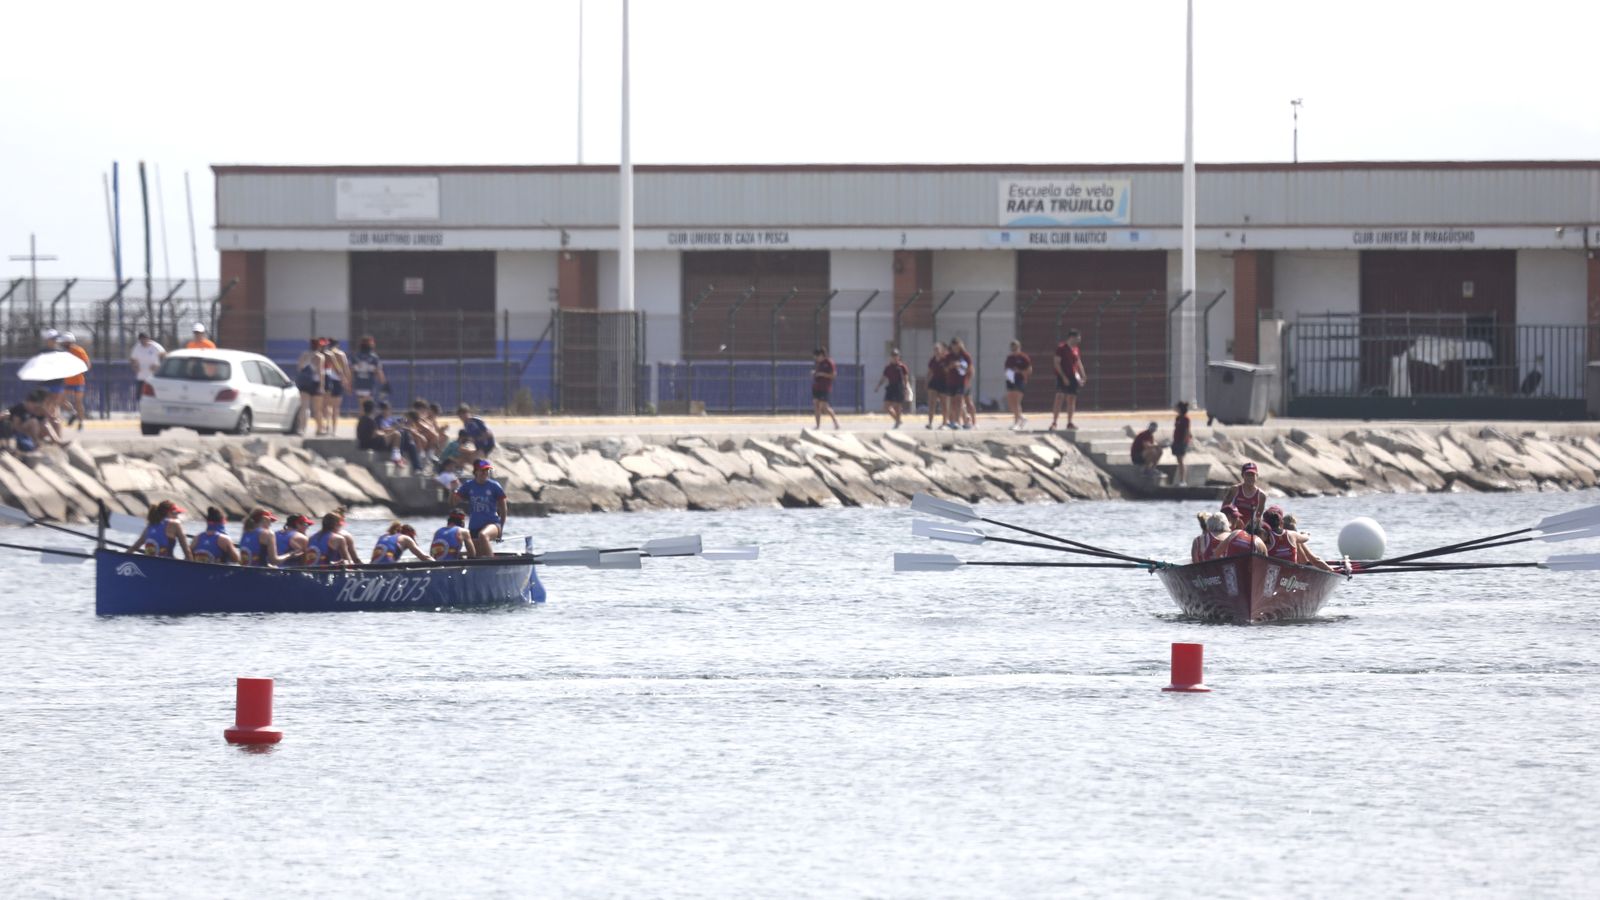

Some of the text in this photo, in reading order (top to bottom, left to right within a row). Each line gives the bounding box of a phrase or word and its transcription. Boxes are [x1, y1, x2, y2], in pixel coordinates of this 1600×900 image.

[1008, 184, 1062, 198] Escuela
[1064, 184, 1082, 198] de
[1007, 199, 1115, 213] RAFA TRUJILLO
[667, 231, 790, 245] CLUB LINENSE DE CAZA Y PESCA
[1029, 231, 1049, 244] REAL
[1051, 231, 1071, 244] CLUB
[1353, 230, 1374, 245] CLUB
[1411, 230, 1421, 245] DE
